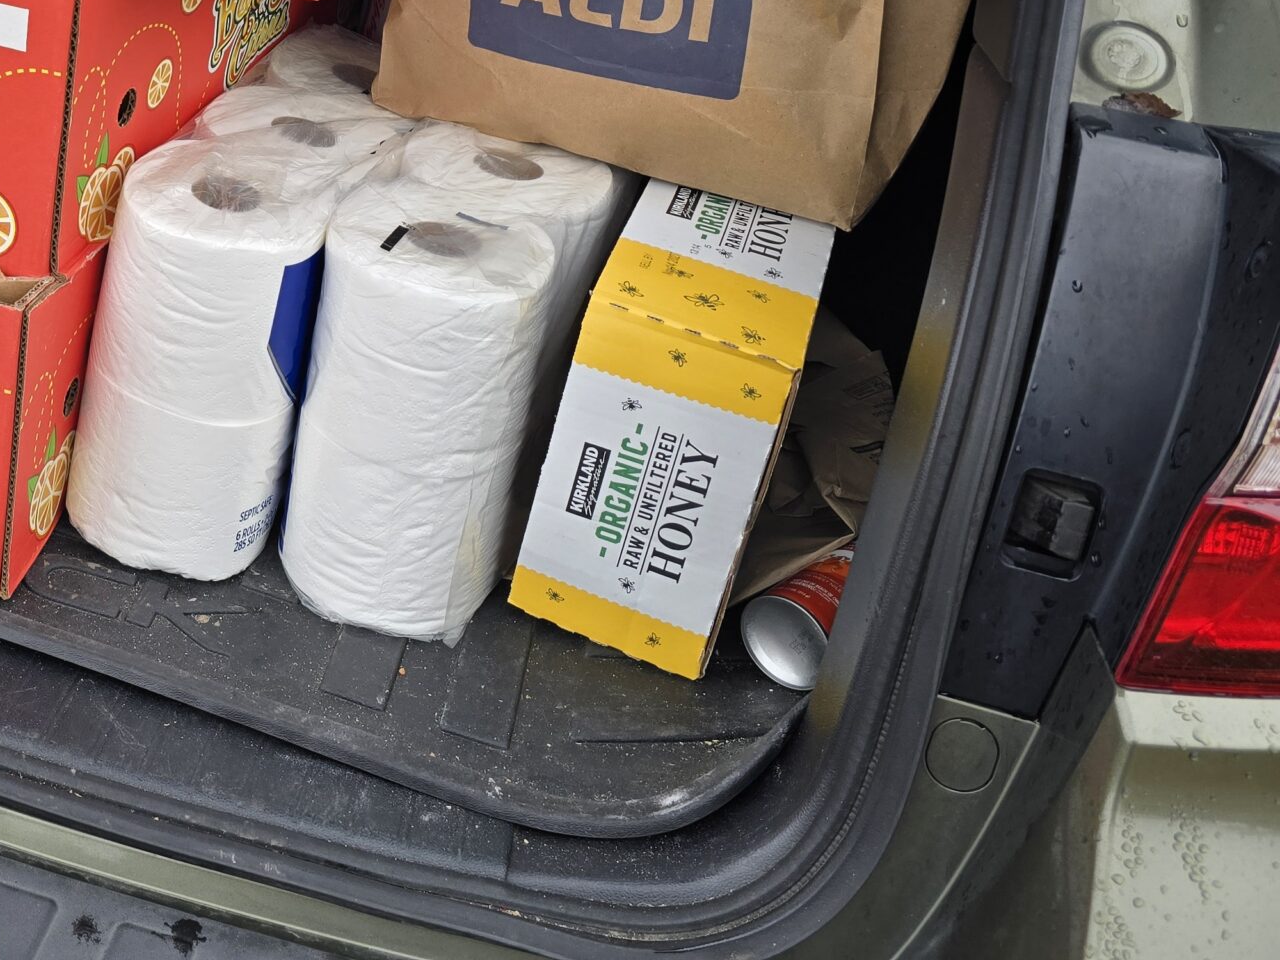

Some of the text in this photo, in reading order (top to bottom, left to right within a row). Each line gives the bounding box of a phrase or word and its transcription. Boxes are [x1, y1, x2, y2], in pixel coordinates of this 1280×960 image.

[670, 187, 692, 216] KIRKLAND
[725, 234, 743, 249] RAW
[570, 446, 599, 513] KIRKLAND
[583, 451, 607, 517] Signature
[595, 437, 649, 544] ORGANIC
[623, 432, 677, 570] RAW & UNFILTERED
[235, 530, 242, 541] 6
[241, 519, 261, 539] ROLLS
[239, 504, 261, 522] SEPTIC
[646, 439, 719, 584] HONEY
[233, 539, 247, 553] 285
